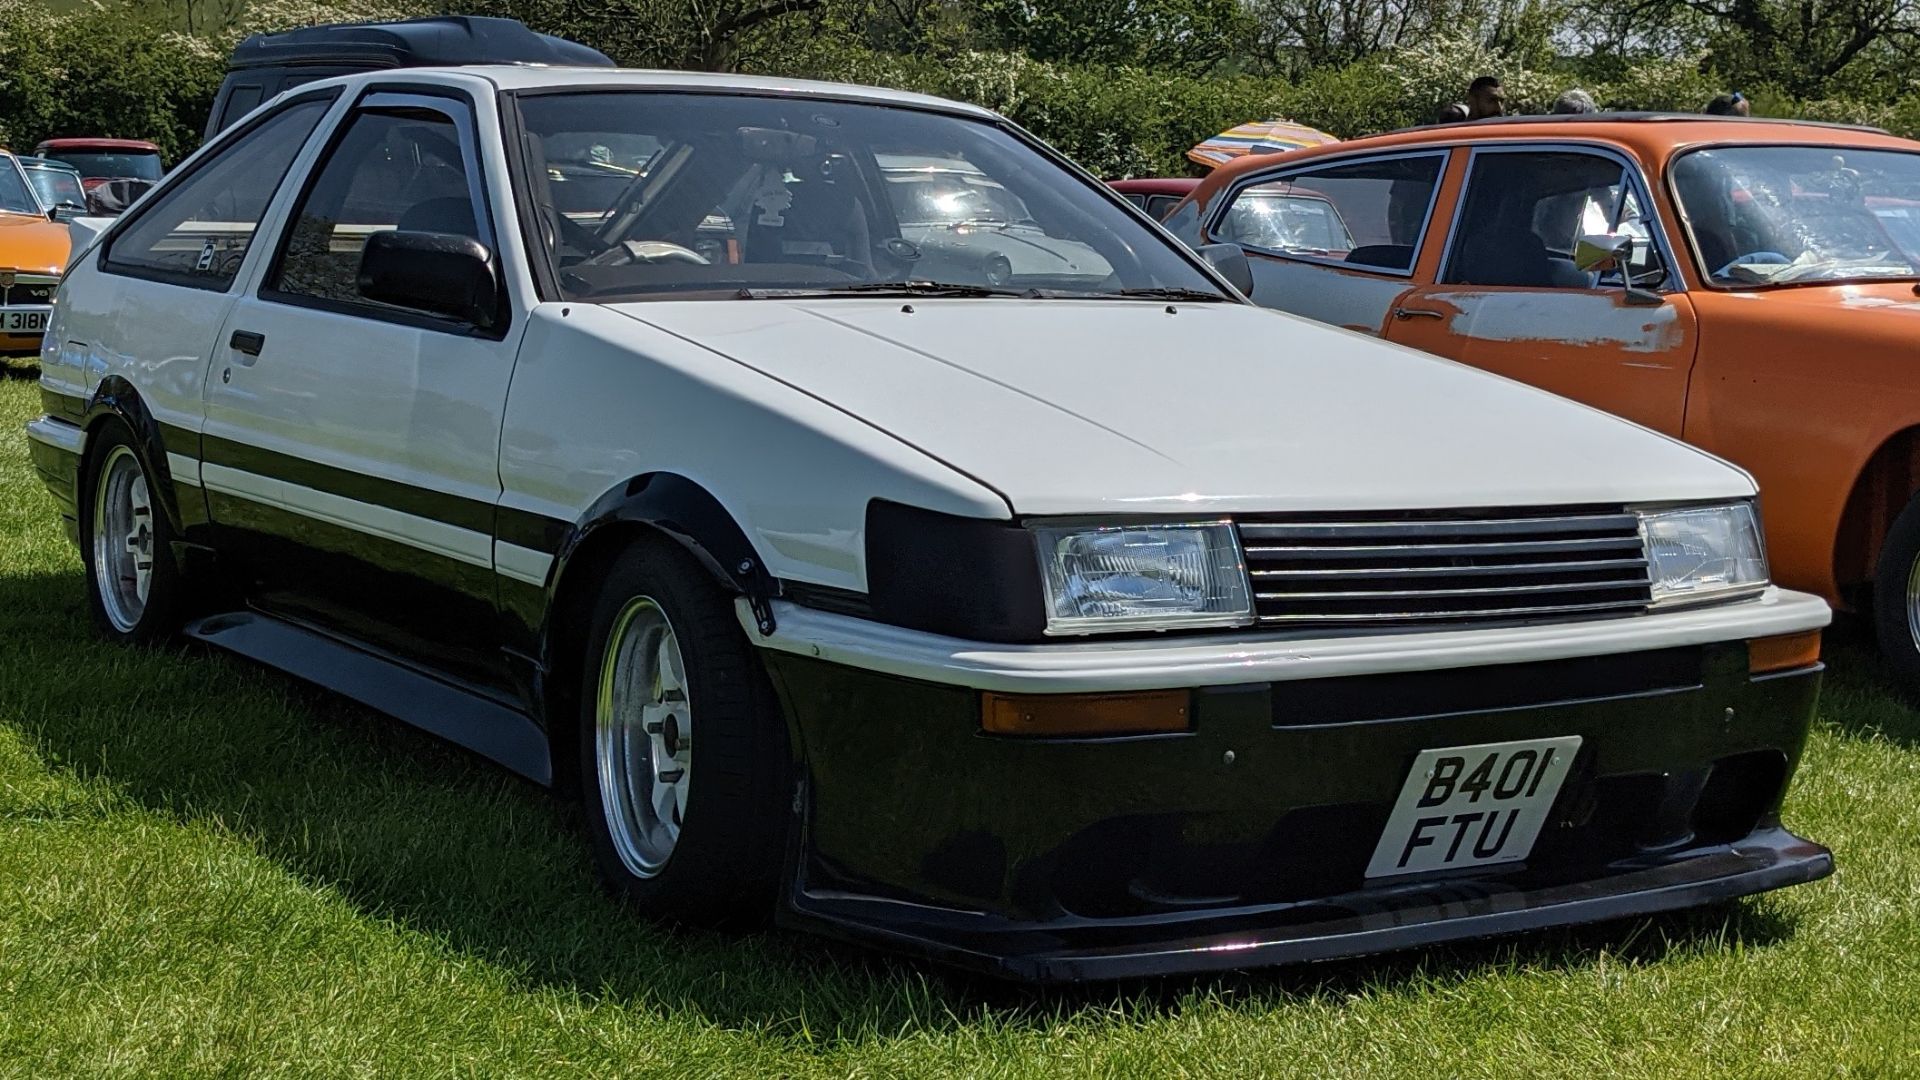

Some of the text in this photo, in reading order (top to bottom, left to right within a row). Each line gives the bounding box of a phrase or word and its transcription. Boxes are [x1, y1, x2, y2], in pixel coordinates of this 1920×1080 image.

[30, 289, 48, 297] V8
[10, 312, 51, 329] 318N
[1416, 747, 1556, 809] B401
[1396, 808, 1521, 868] FTU
